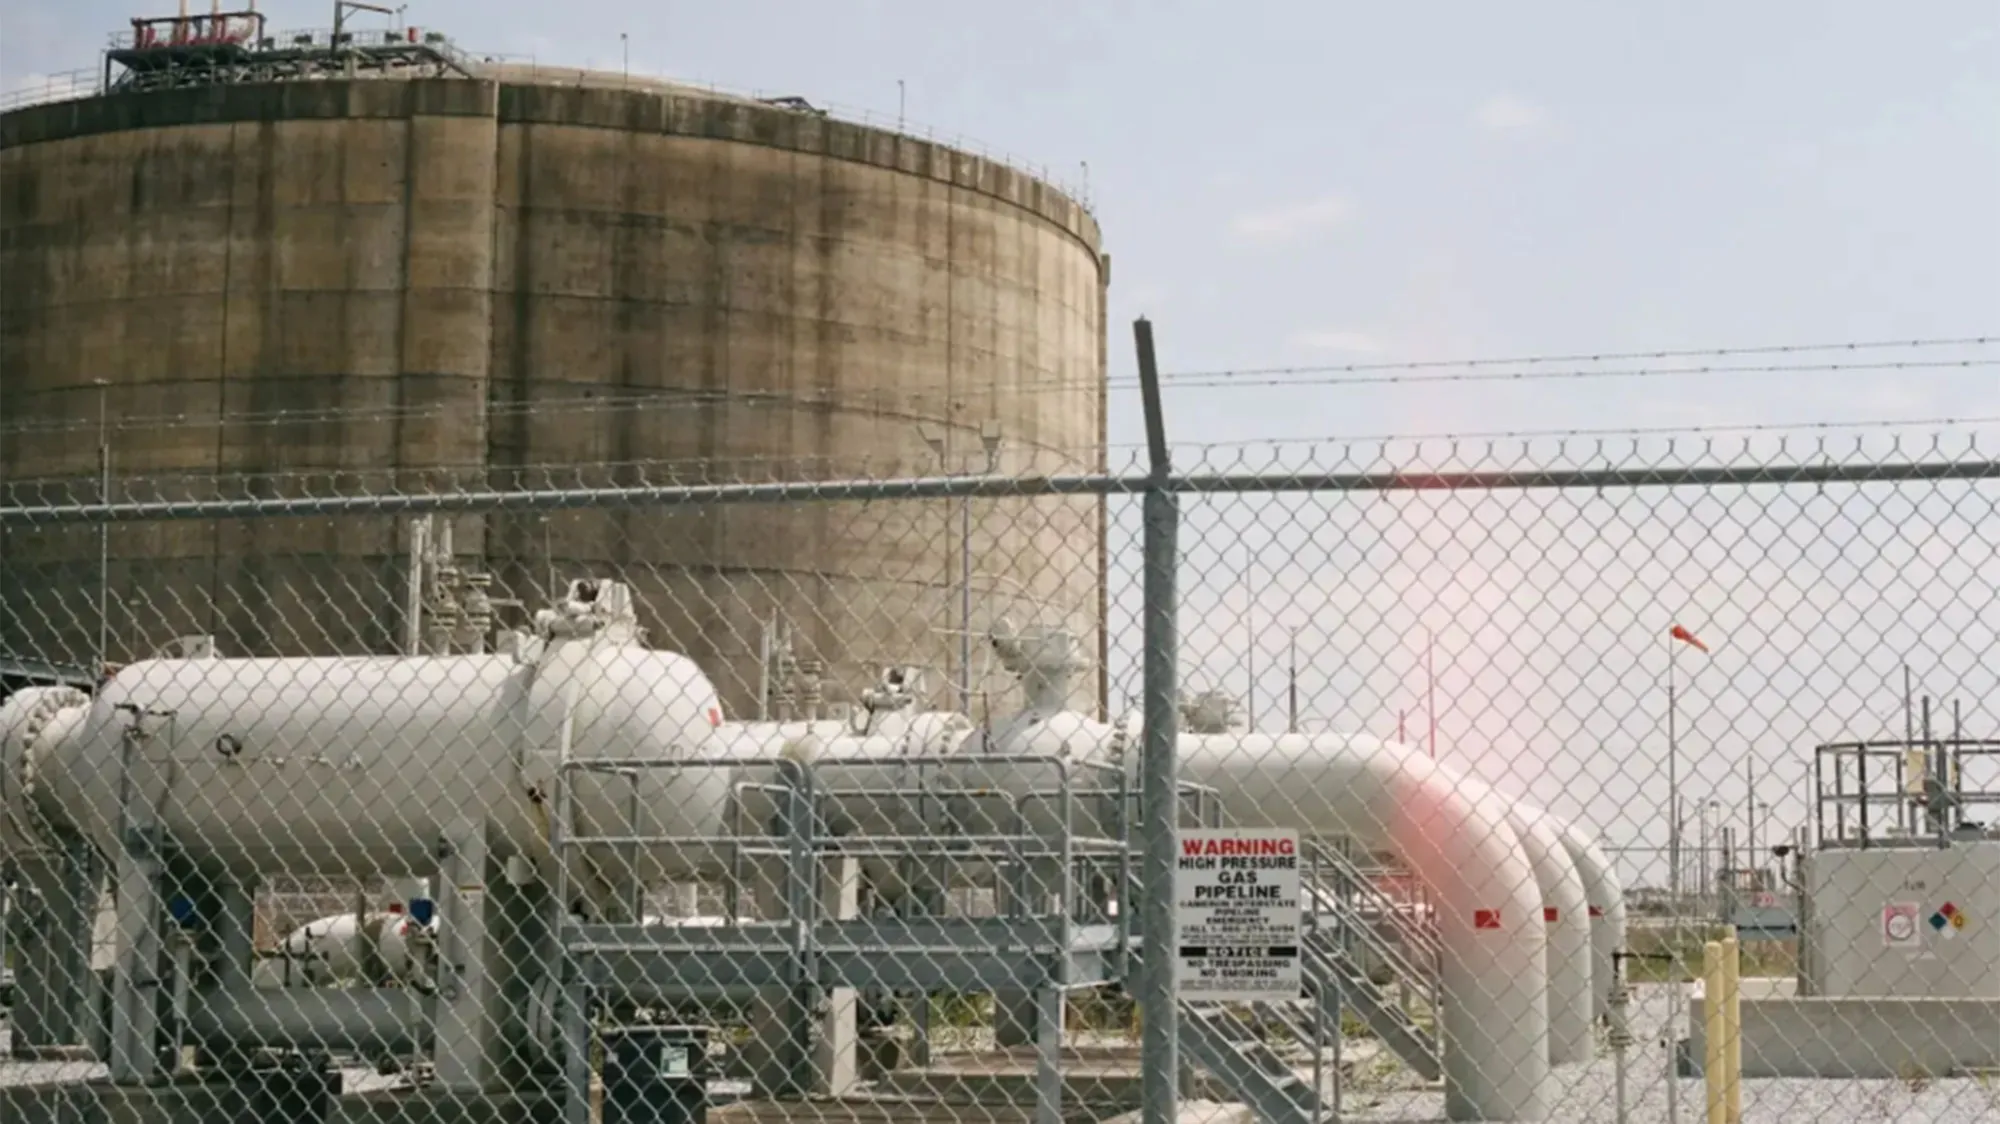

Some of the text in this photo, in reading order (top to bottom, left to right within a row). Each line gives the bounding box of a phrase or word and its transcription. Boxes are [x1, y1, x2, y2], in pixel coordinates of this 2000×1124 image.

[1182, 838, 1295, 856] WARNING
[1179, 857, 1296, 869] HIGH PRESSURE
[1218, 871, 1258, 884] GAS
[1195, 886, 1281, 898] PIPELINE
[1187, 960, 1291, 968] NO TRESPASSING
[1200, 969, 1278, 978] NO SMOKING
